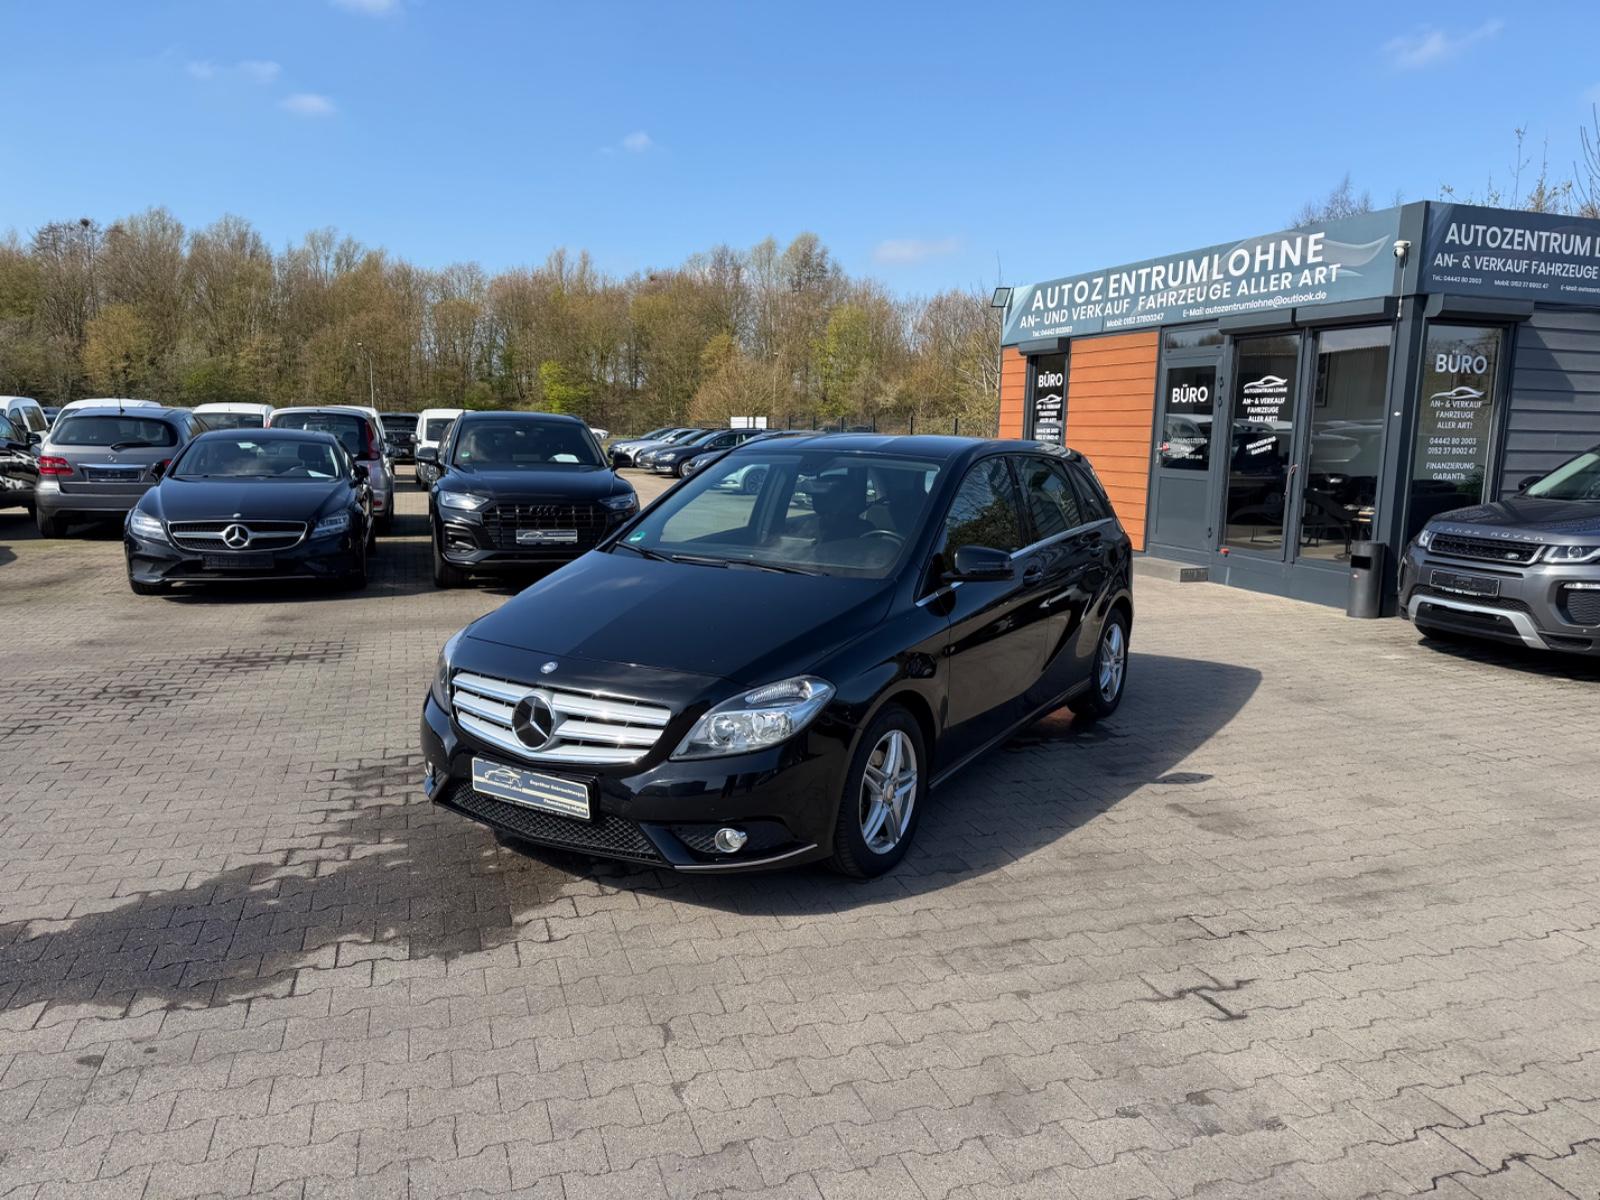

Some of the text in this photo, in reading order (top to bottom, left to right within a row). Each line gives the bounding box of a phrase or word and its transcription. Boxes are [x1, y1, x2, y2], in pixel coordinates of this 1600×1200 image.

[1445, 222, 1592, 257] AUTOZENTRUM
[1434, 252, 1599, 280] AN- & VERKAUF FAHRZEUGE
[1019, 264, 1342, 330] AN- UND VERKAUF FAHRZEUGE ALLER ART
[1435, 349, 1488, 375] BÜRO
[1038, 370, 1063, 388] BÜRO
[1171, 383, 1209, 403] BÜRO
[1260, 396, 1286, 405] VERKAUF
[1452, 400, 1483, 409] VERKAUF
[1247, 406, 1279, 414] FAHRZEUGE
[1435, 410, 1475, 419] FAHRZEUGE
[1437, 421, 1456, 429] ALLER
[1429, 437, 1451, 445] 04442
[1468, 447, 1478, 455] 47
[1425, 462, 1475, 470] FINANZIERUNG
[1490, 531, 1544, 541] ROVER
